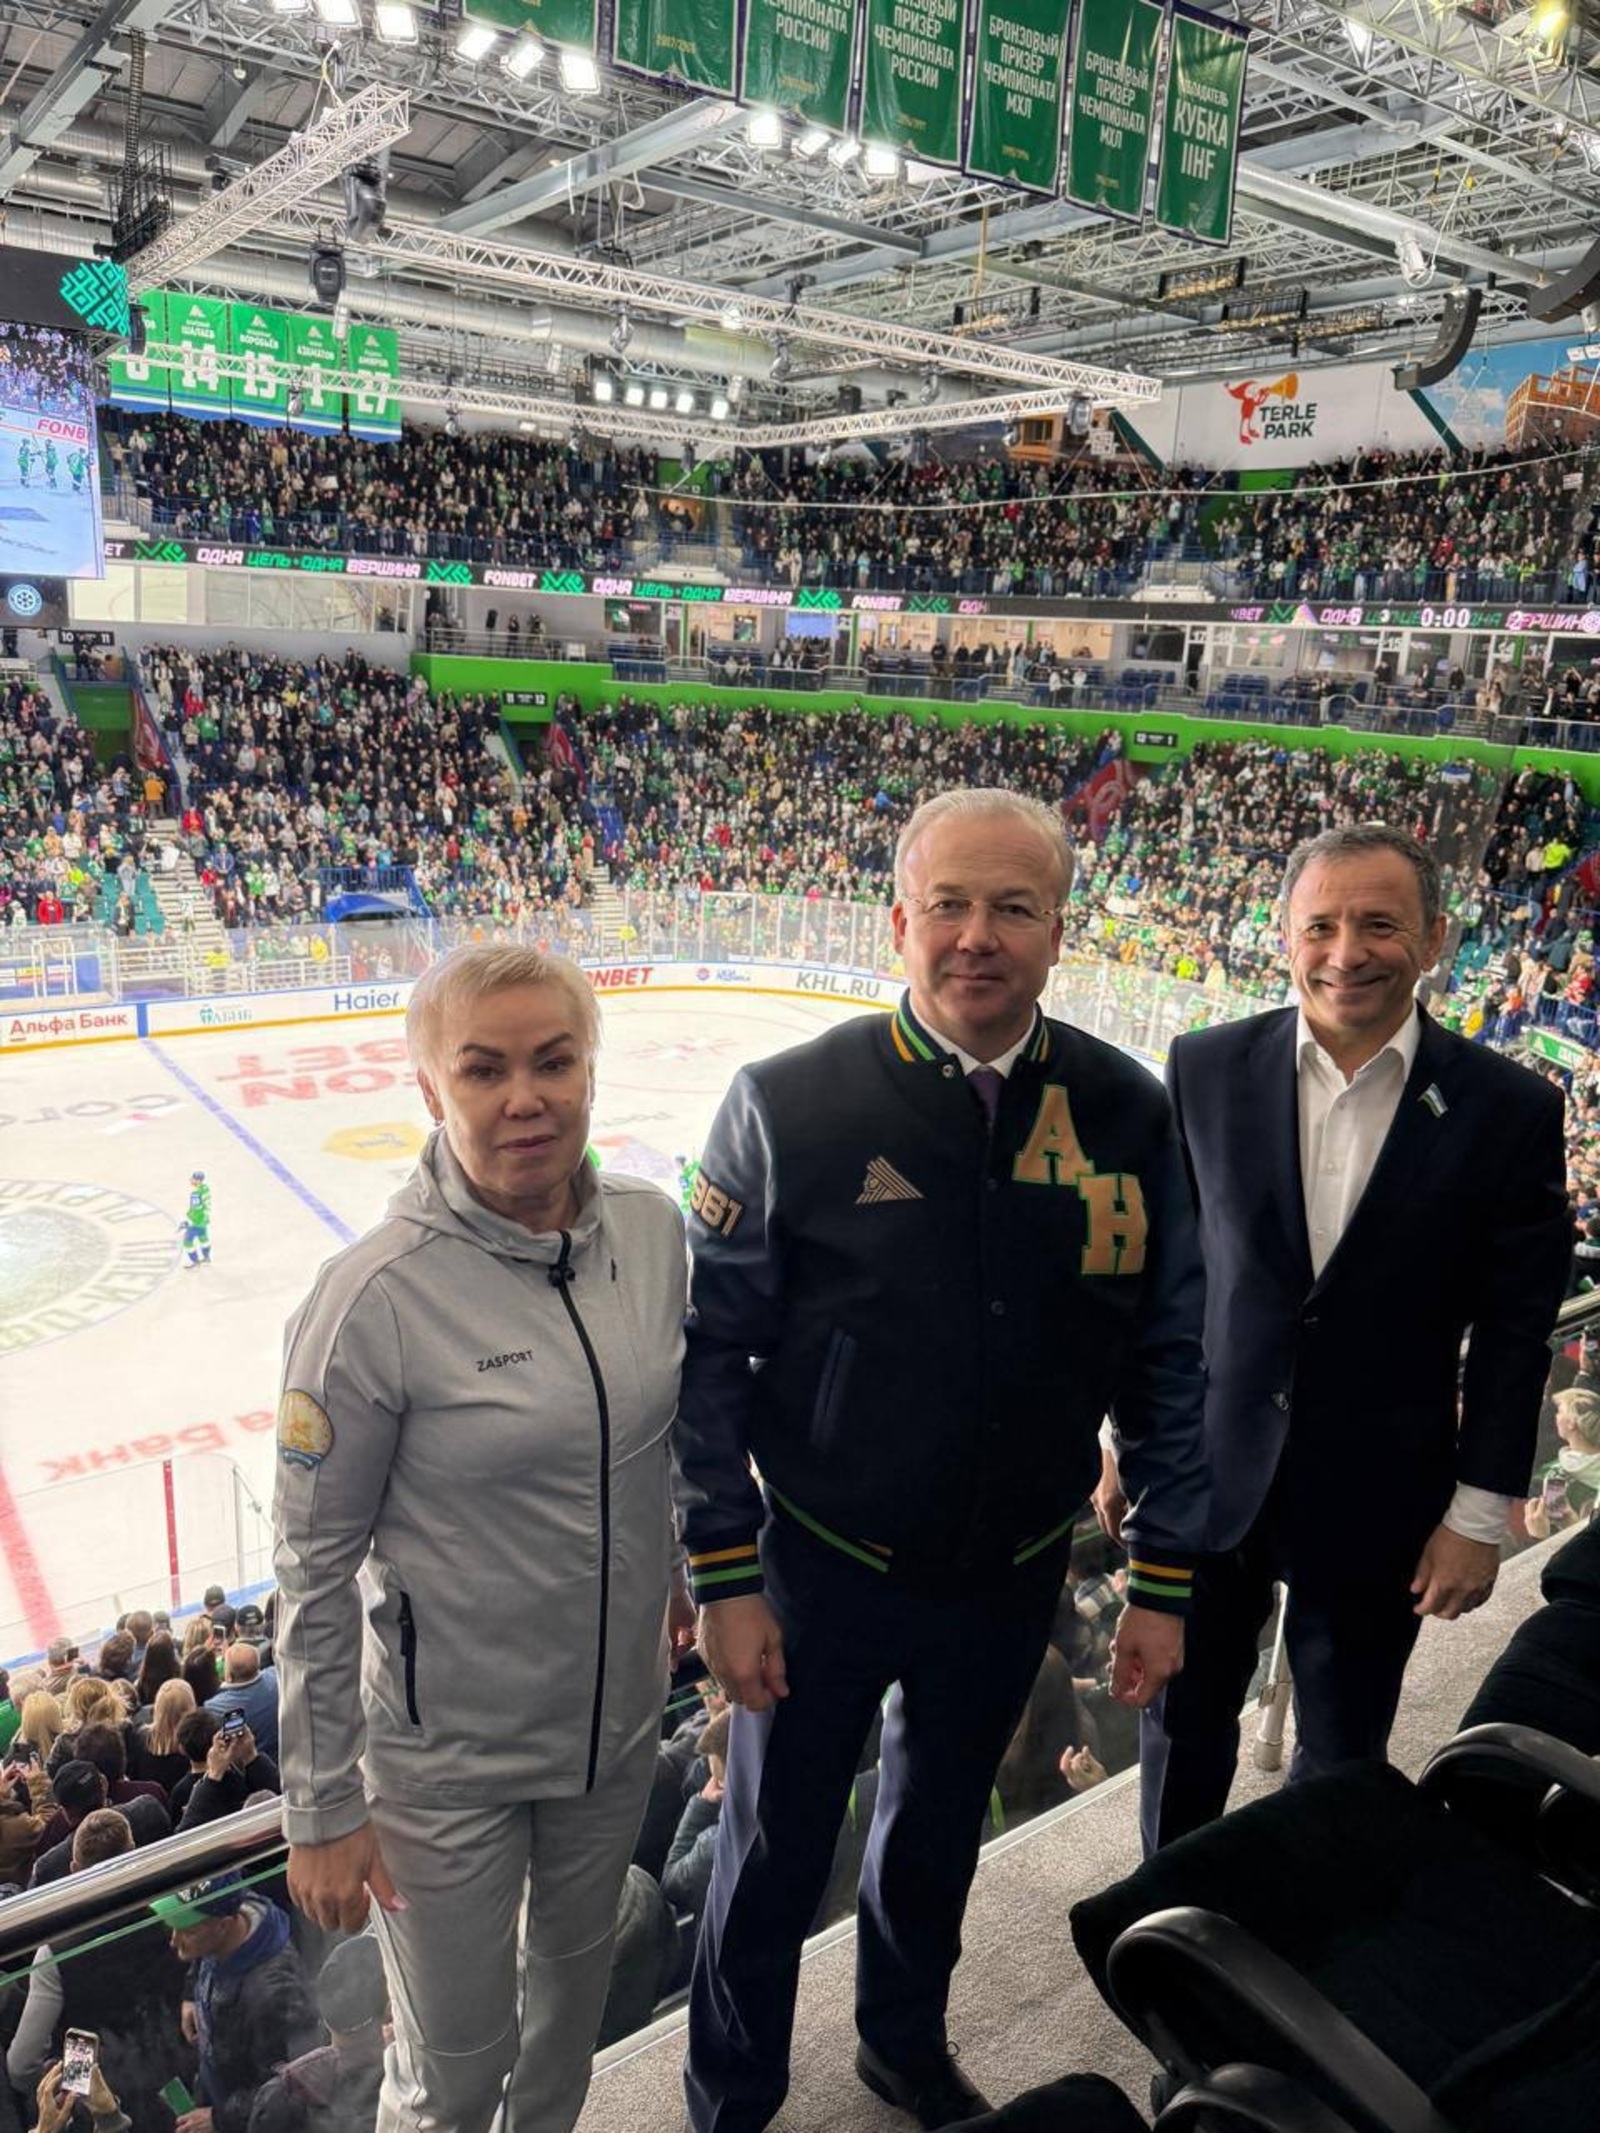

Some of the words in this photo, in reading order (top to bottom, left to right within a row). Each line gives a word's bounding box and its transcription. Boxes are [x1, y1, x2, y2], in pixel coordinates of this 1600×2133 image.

[775, 11, 830, 52] РОССИИ
[893, 5, 942, 40] ПРИЗЁР
[989, 15, 1060, 57] БРОНЗОВЫЙ
[875, 23, 955, 71] ЧЕМПИОНАТА
[891, 53, 939, 89] РОССИИ
[983, 60, 1056, 103] ЧЕМПИОНАТА
[1085, 51, 1149, 91] БРОНЗОВЫЙ
[1006, 91, 1032, 119] МХЛ
[1079, 94, 1146, 136] ЧЕМПИОНАТА
[1099, 124, 1123, 149] МХЛ
[1173, 98, 1229, 149] КУБКА
[181, 340, 219, 391] 14
[243, 349, 277, 399] 15
[1259, 403, 1318, 422] TERLE
[1263, 420, 1314, 441] PARK
[196, 548, 245, 565] ОДНА
[301, 555, 345, 574] ОДНА
[592, 577, 634, 596] ОДНА
[1421, 607, 1471, 628] 0:00
[61, 631, 75, 643] 10
[795, 971, 881, 999] KHL.RU
[333, 990, 401, 1012] Haier
[9, 1015, 76, 1036] Альфа
[79, 1012, 129, 1029] Банк
[476, 1349, 535, 1373] ZASPORT
